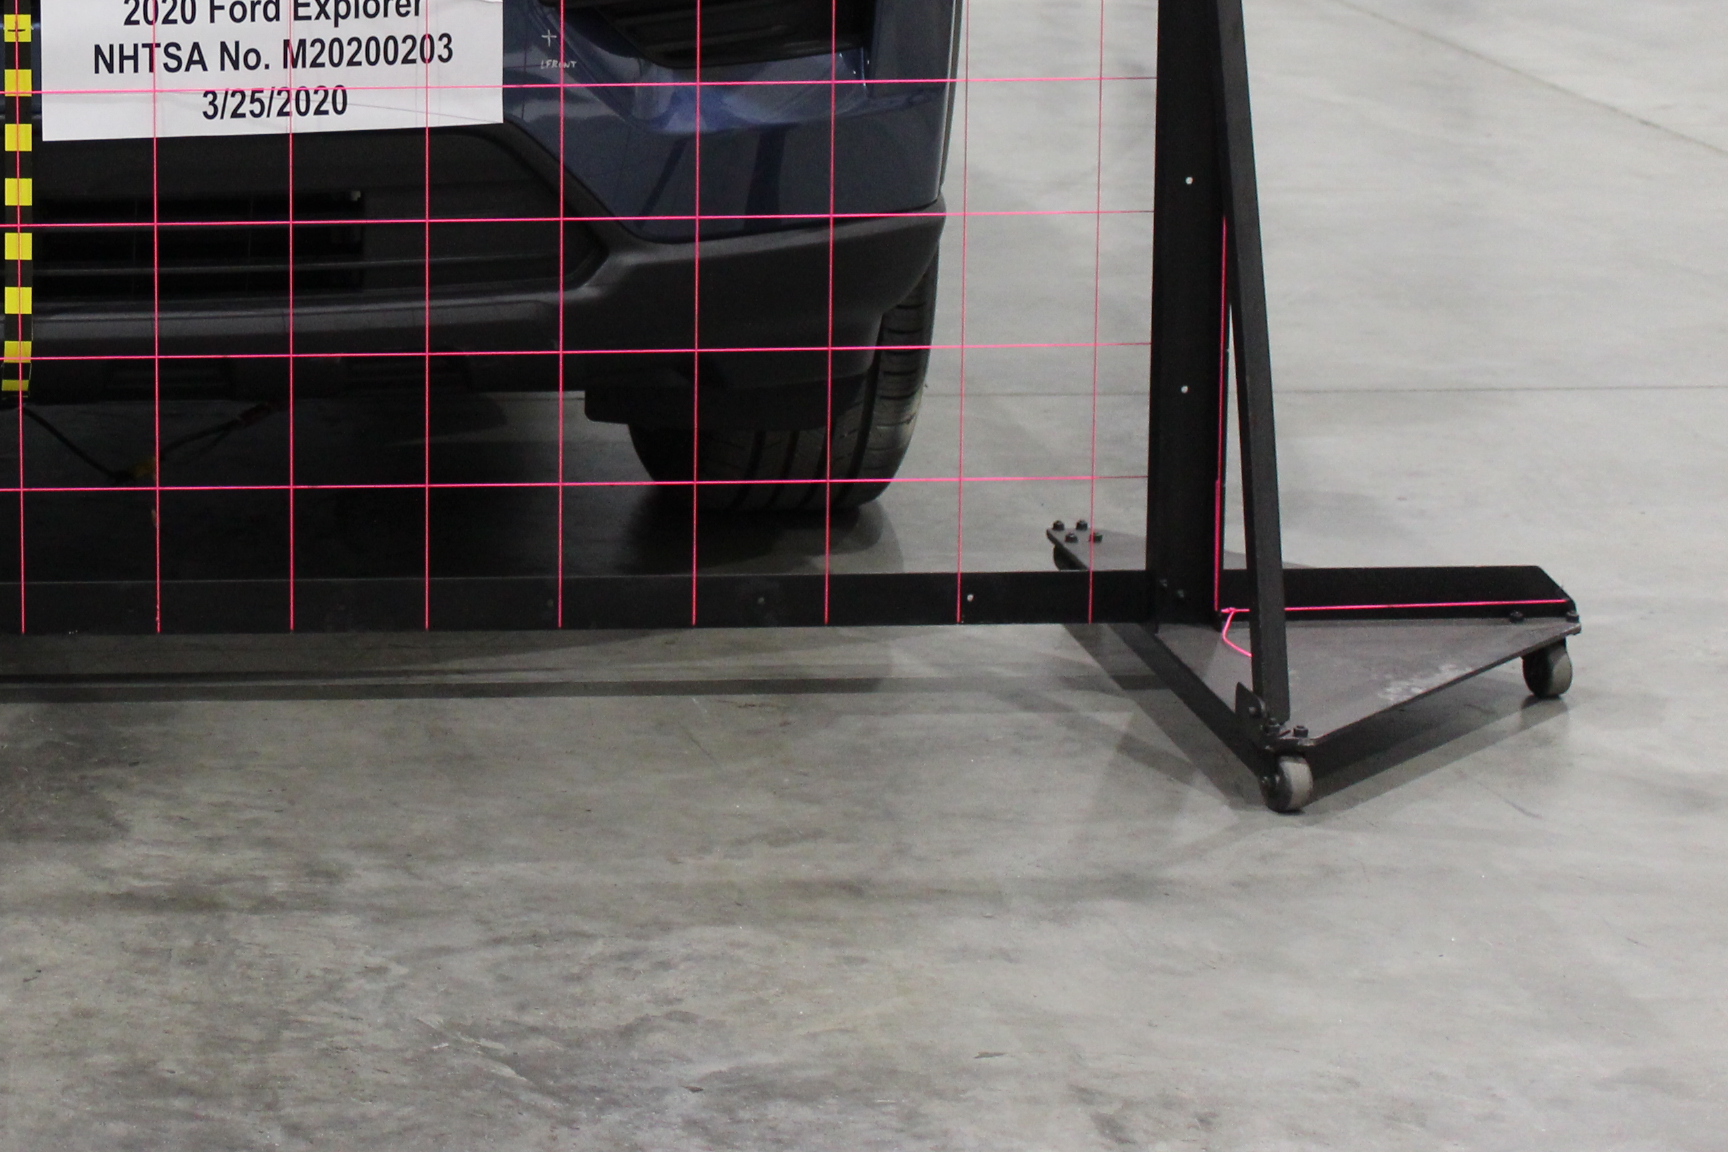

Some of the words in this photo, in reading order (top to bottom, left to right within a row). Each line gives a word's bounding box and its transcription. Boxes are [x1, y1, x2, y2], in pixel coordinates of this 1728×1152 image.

[94, 41, 208, 75] NHTSA
[219, 40, 271, 72] No.
[282, 32, 454, 70] M20200203
[202, 84, 348, 121] 3/25/2020
